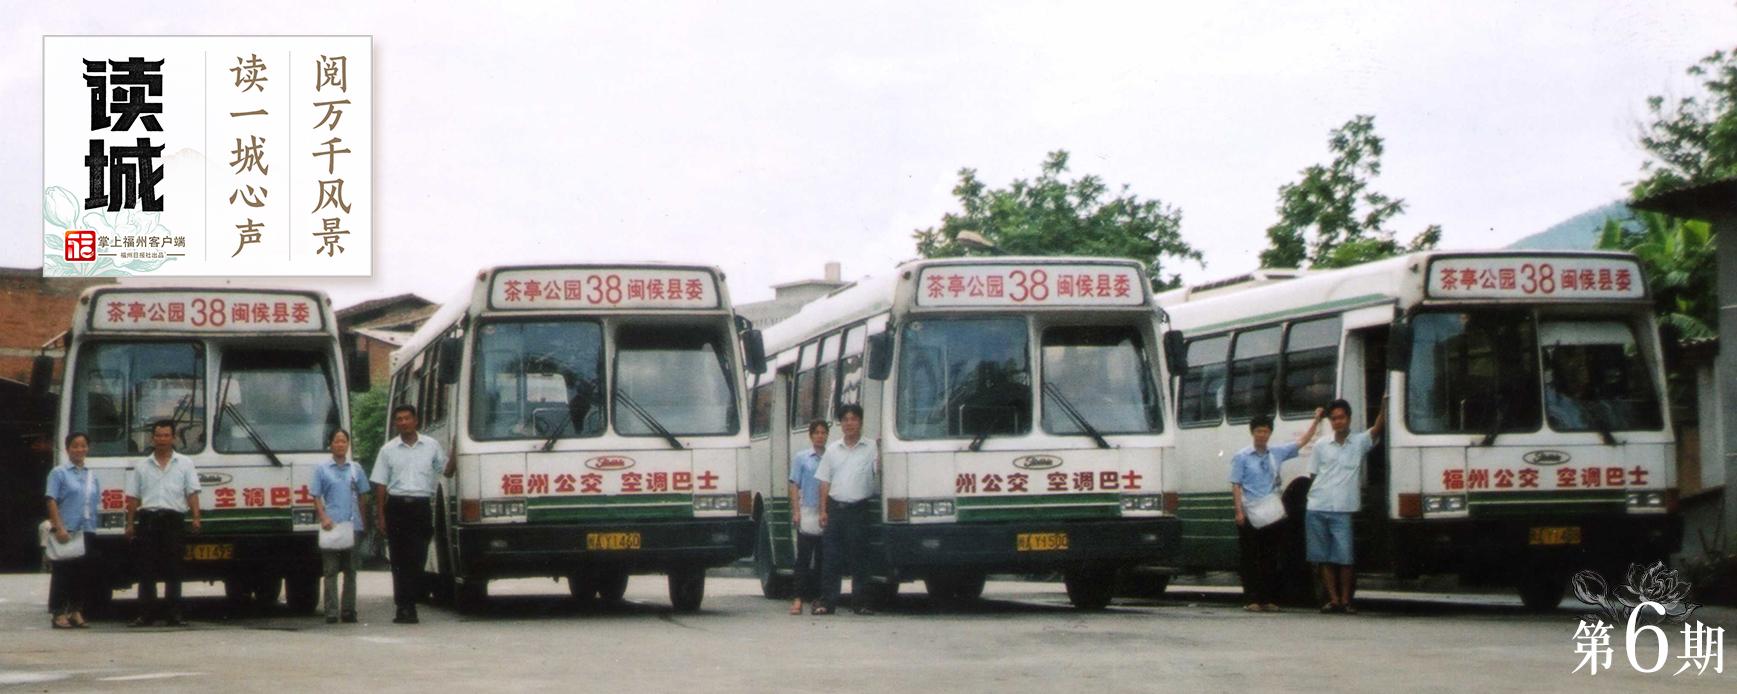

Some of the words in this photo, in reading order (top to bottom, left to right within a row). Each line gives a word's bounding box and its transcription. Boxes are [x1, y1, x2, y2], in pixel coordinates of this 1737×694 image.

[504, 279, 582, 302] 茶亭公园
[586, 275, 623, 304] 38
[627, 278, 703, 300] 闽侯县委
[927, 275, 1004, 298] 茶亭公园
[1009, 269, 1049, 302] 38
[1057, 274, 1131, 298] 闽侯县委
[1440, 268, 1516, 290] 茶亭公园
[1521, 263, 1555, 294] 38
[1560, 268, 1632, 291] 闽侯县委
[107, 302, 185, 323] 茶亭公园
[190, 298, 226, 327] 38
[232, 302, 310, 324] 闽侯县委
[501, 472, 604, 495] 福州公交
[620, 470, 719, 493] 空调巴士
[955, 472, 1029, 494] 州公交
[1047, 470, 1143, 492] 空调巴士
[1442, 468, 1539, 491] 福州公交
[1556, 465, 1649, 489] 空调巴士
[214, 485, 316, 508] 空调巴士
